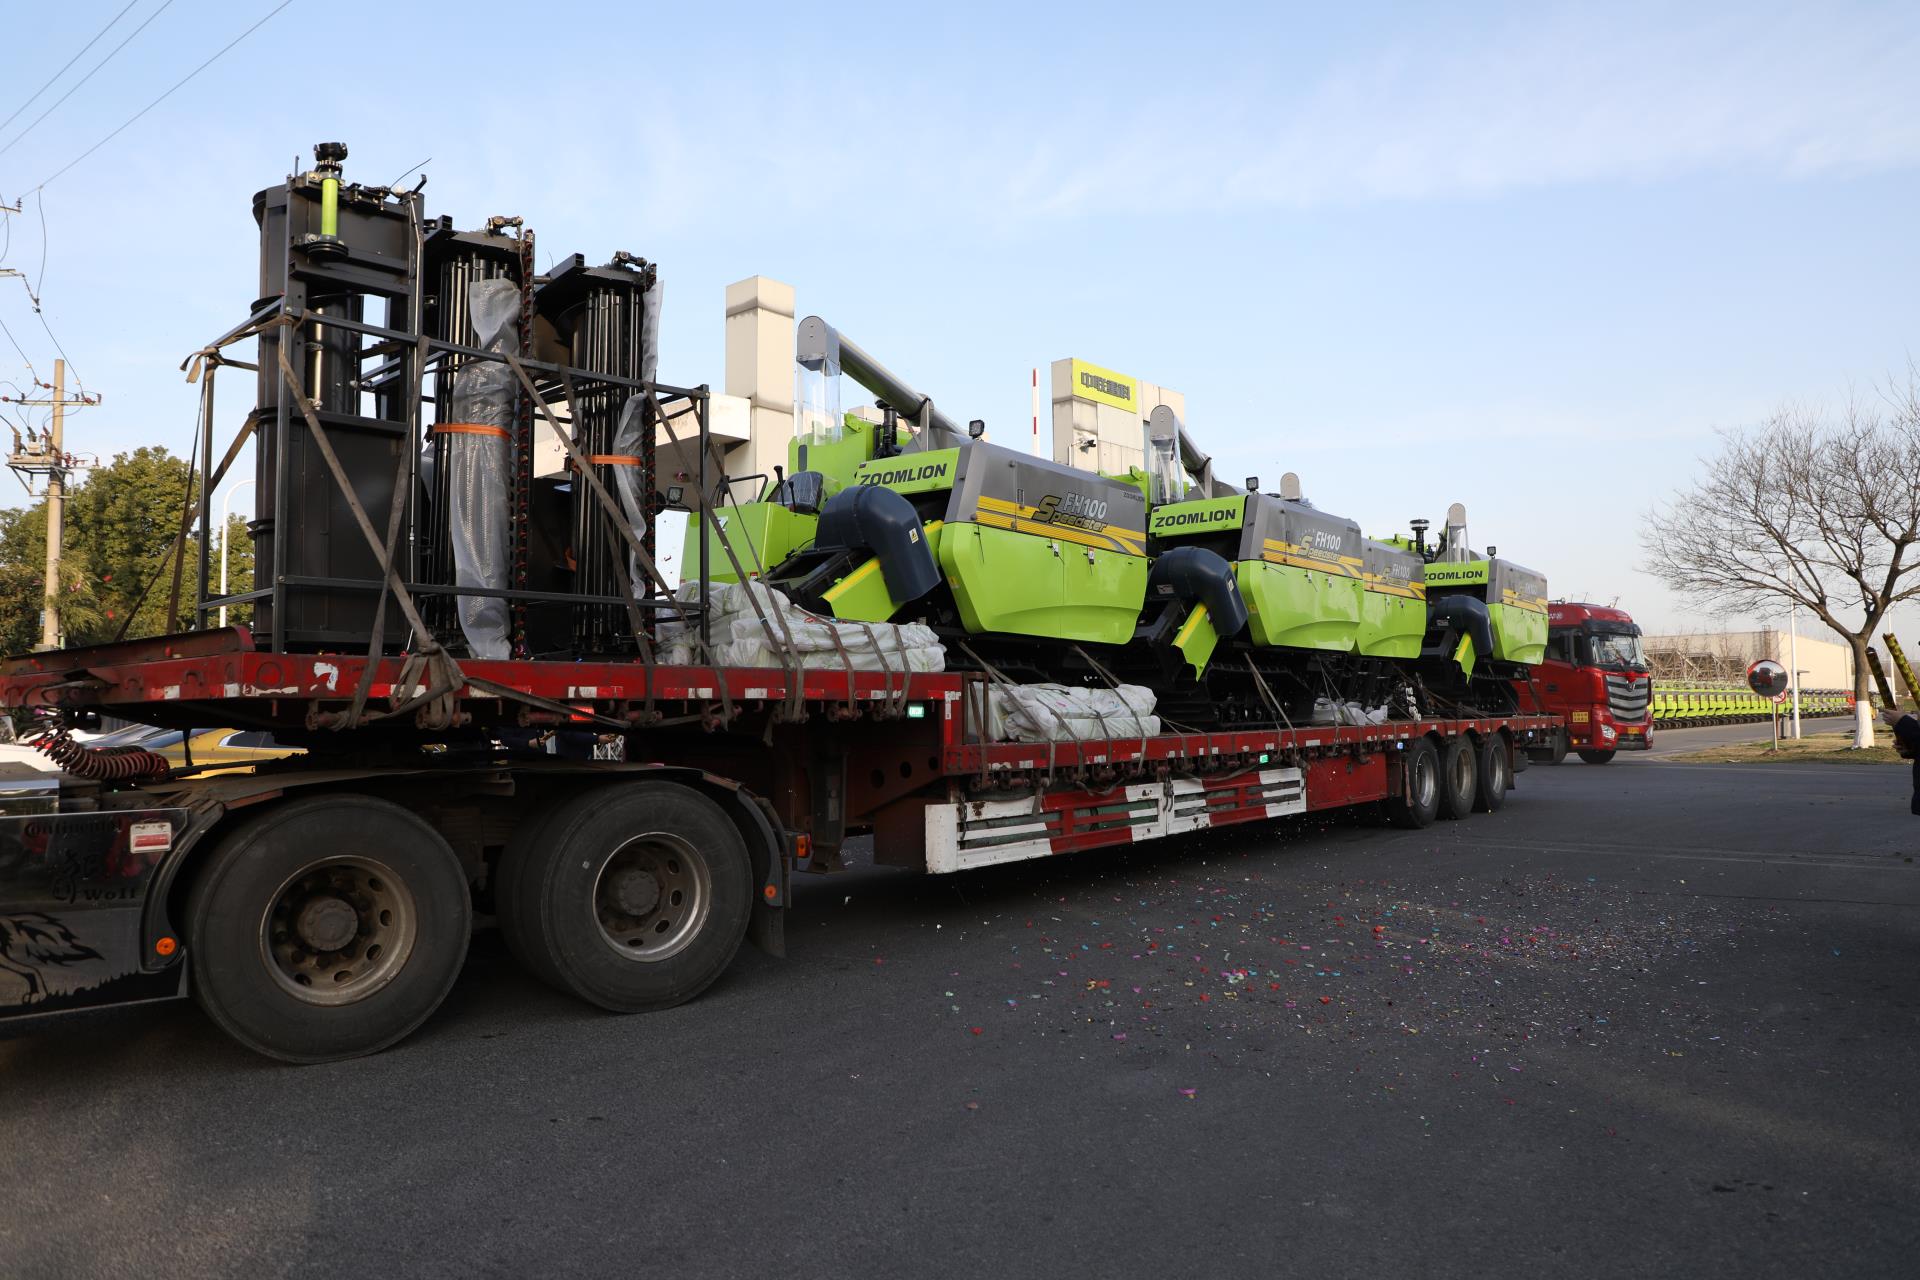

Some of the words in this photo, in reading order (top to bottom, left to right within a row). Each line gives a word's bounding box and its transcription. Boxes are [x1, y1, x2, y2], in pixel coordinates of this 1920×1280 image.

[860, 463, 948, 487] ZOOMLION
[1031, 494, 1109, 533] Speedster
[1063, 491, 1108, 519] FH100
[1154, 508, 1237, 528] ZOOMLION
[1314, 531, 1341, 551] FH100
